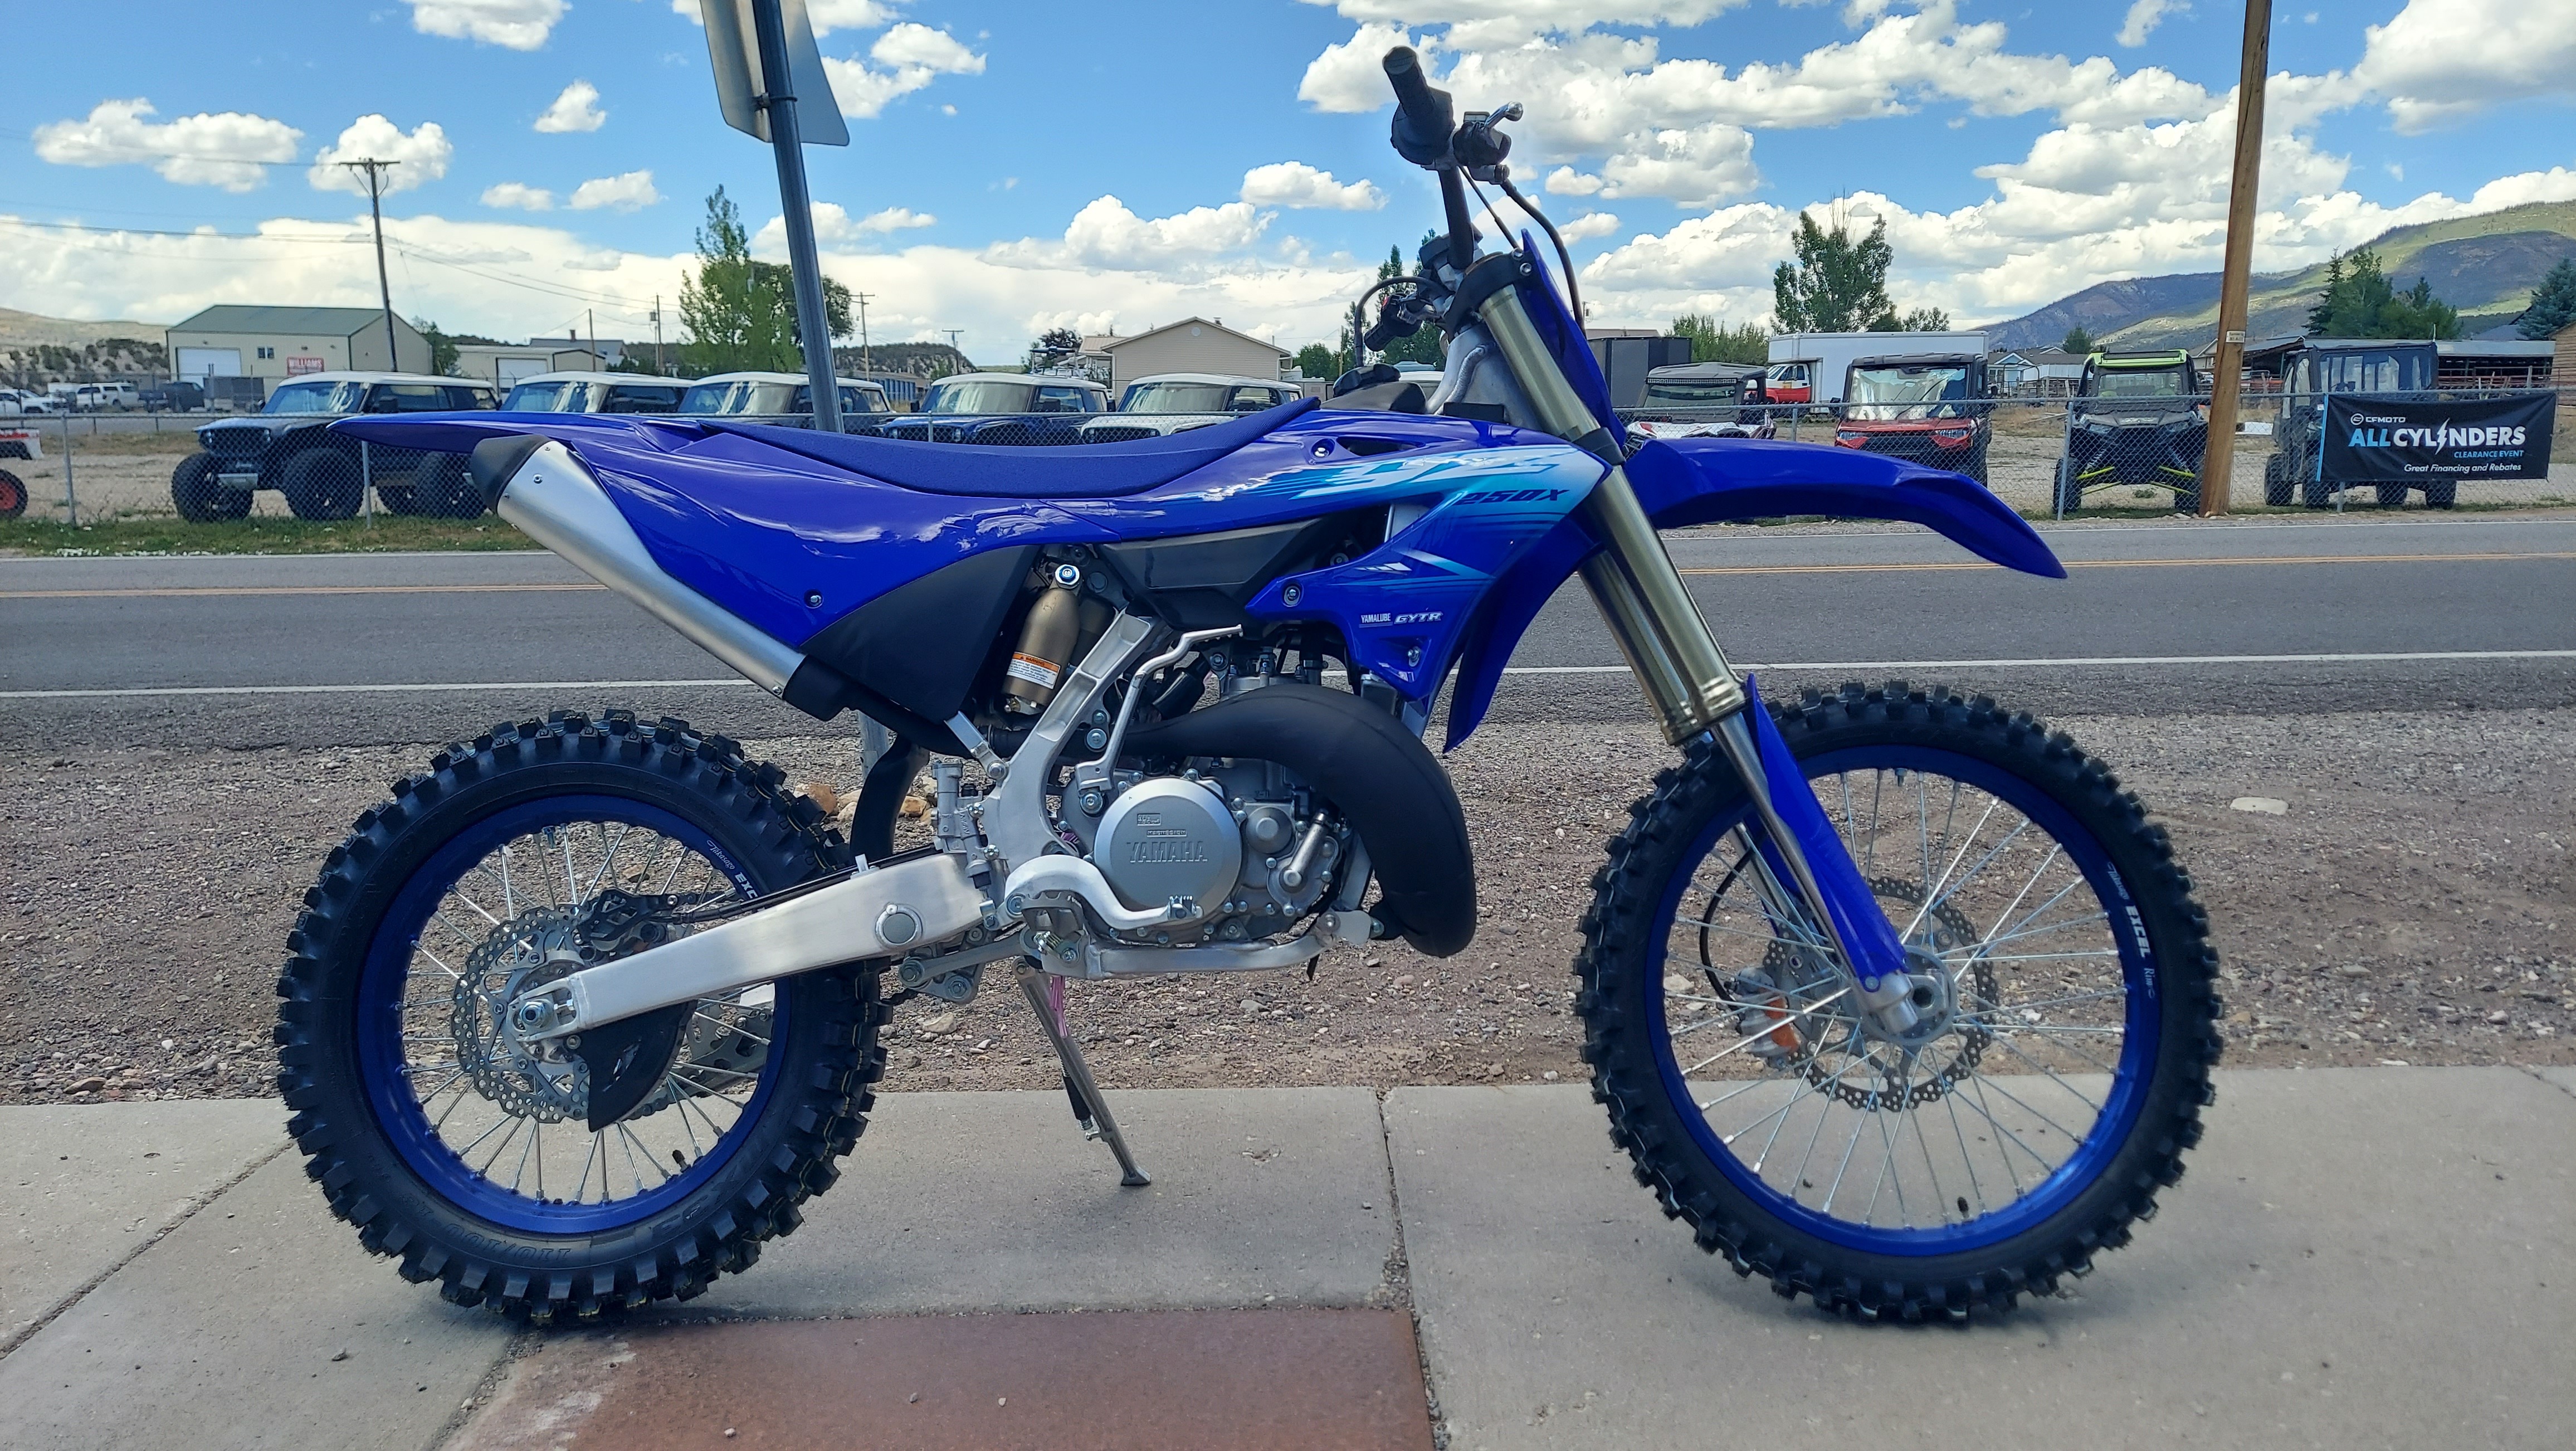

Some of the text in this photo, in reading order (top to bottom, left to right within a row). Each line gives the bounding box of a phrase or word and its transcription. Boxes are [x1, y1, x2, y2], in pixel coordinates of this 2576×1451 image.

[2348, 428, 2391, 447] ALL
[2404, 464, 2429, 472] Great
[2430, 464, 2470, 474] Financing
[2471, 463, 2489, 471] and
[1451, 489, 1570, 506] 250X
[1361, 611, 1443, 624] YAMALUBE GYTR
[1126, 841, 1208, 863] YAMAHA
[706, 840, 758, 899] Takasago EXC
[2125, 905, 2151, 958] EXCEL
